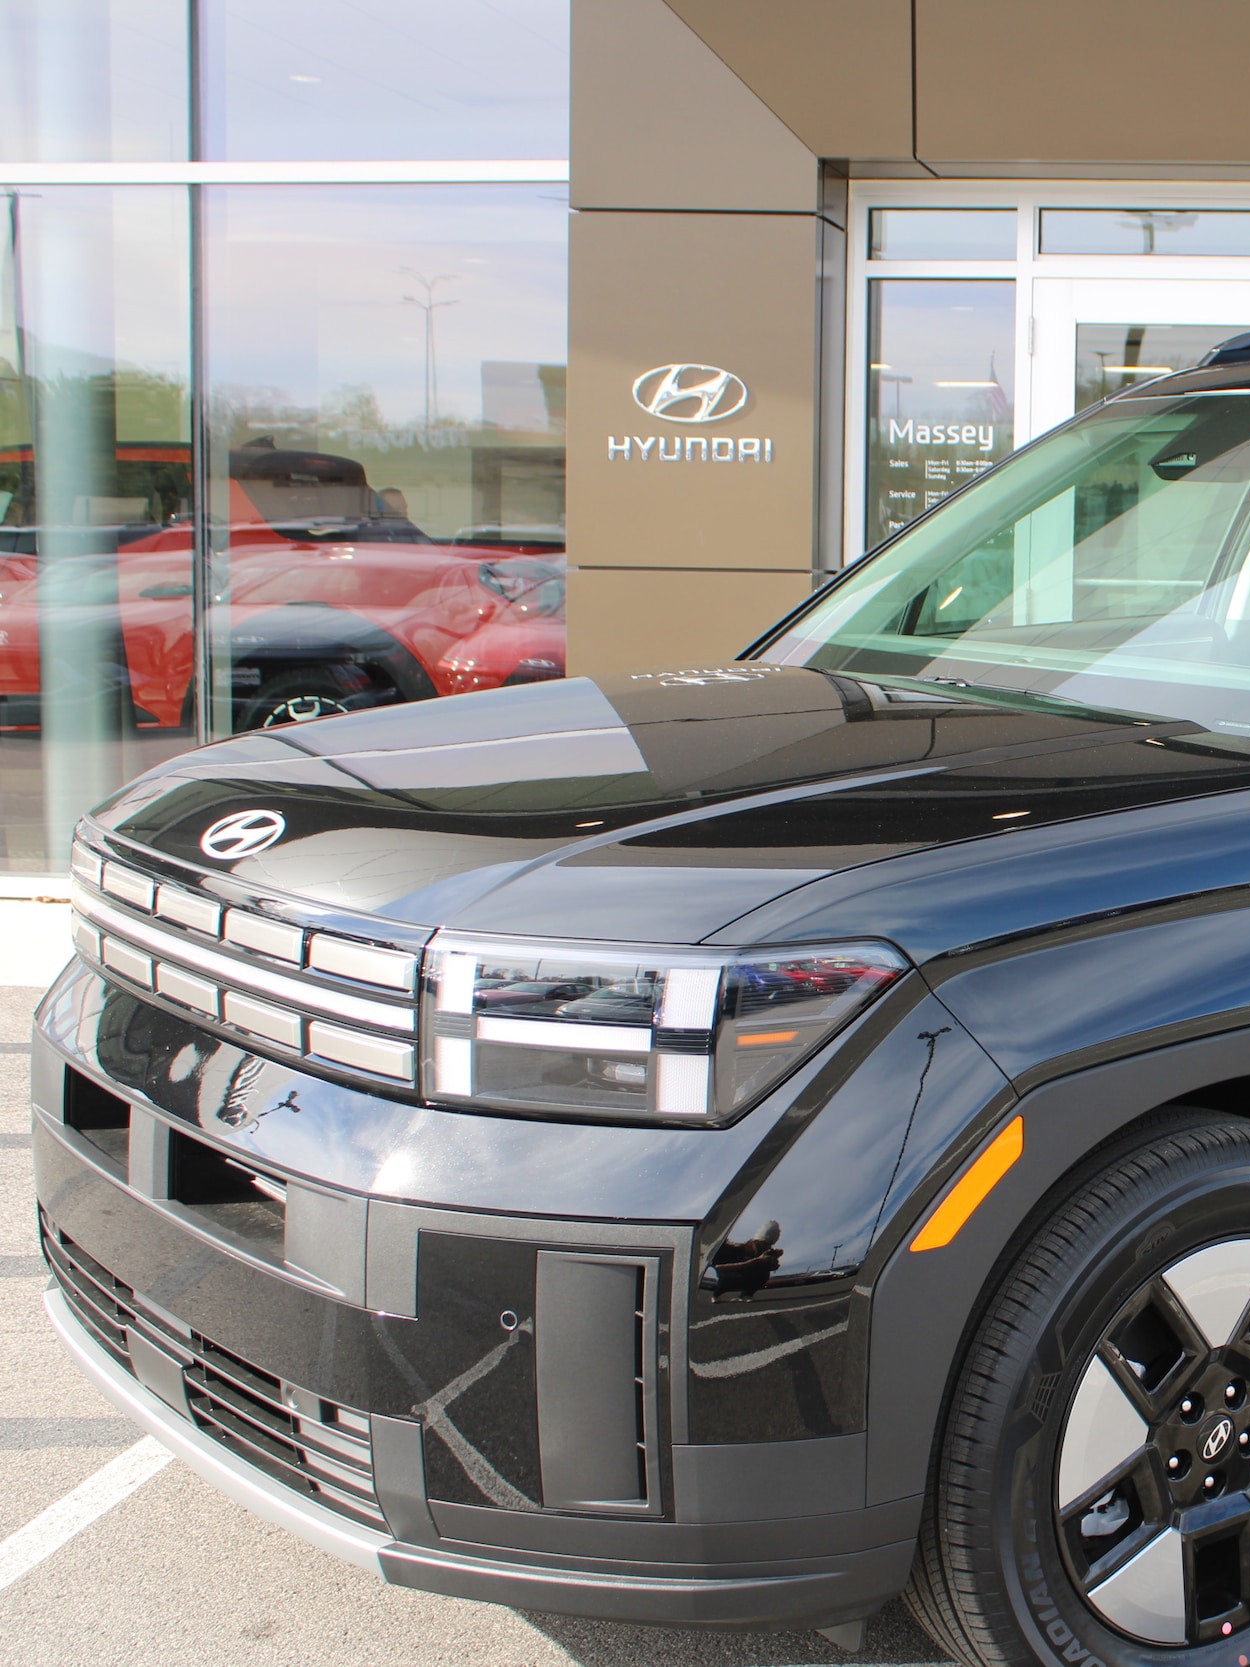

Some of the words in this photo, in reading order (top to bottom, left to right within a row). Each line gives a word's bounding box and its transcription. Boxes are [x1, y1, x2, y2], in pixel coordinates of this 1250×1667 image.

[889, 418, 994, 452] Massey
[607, 435, 772, 463] HYUNDAI
[889, 459, 909, 468] Sales
[889, 490, 916, 499] Service
